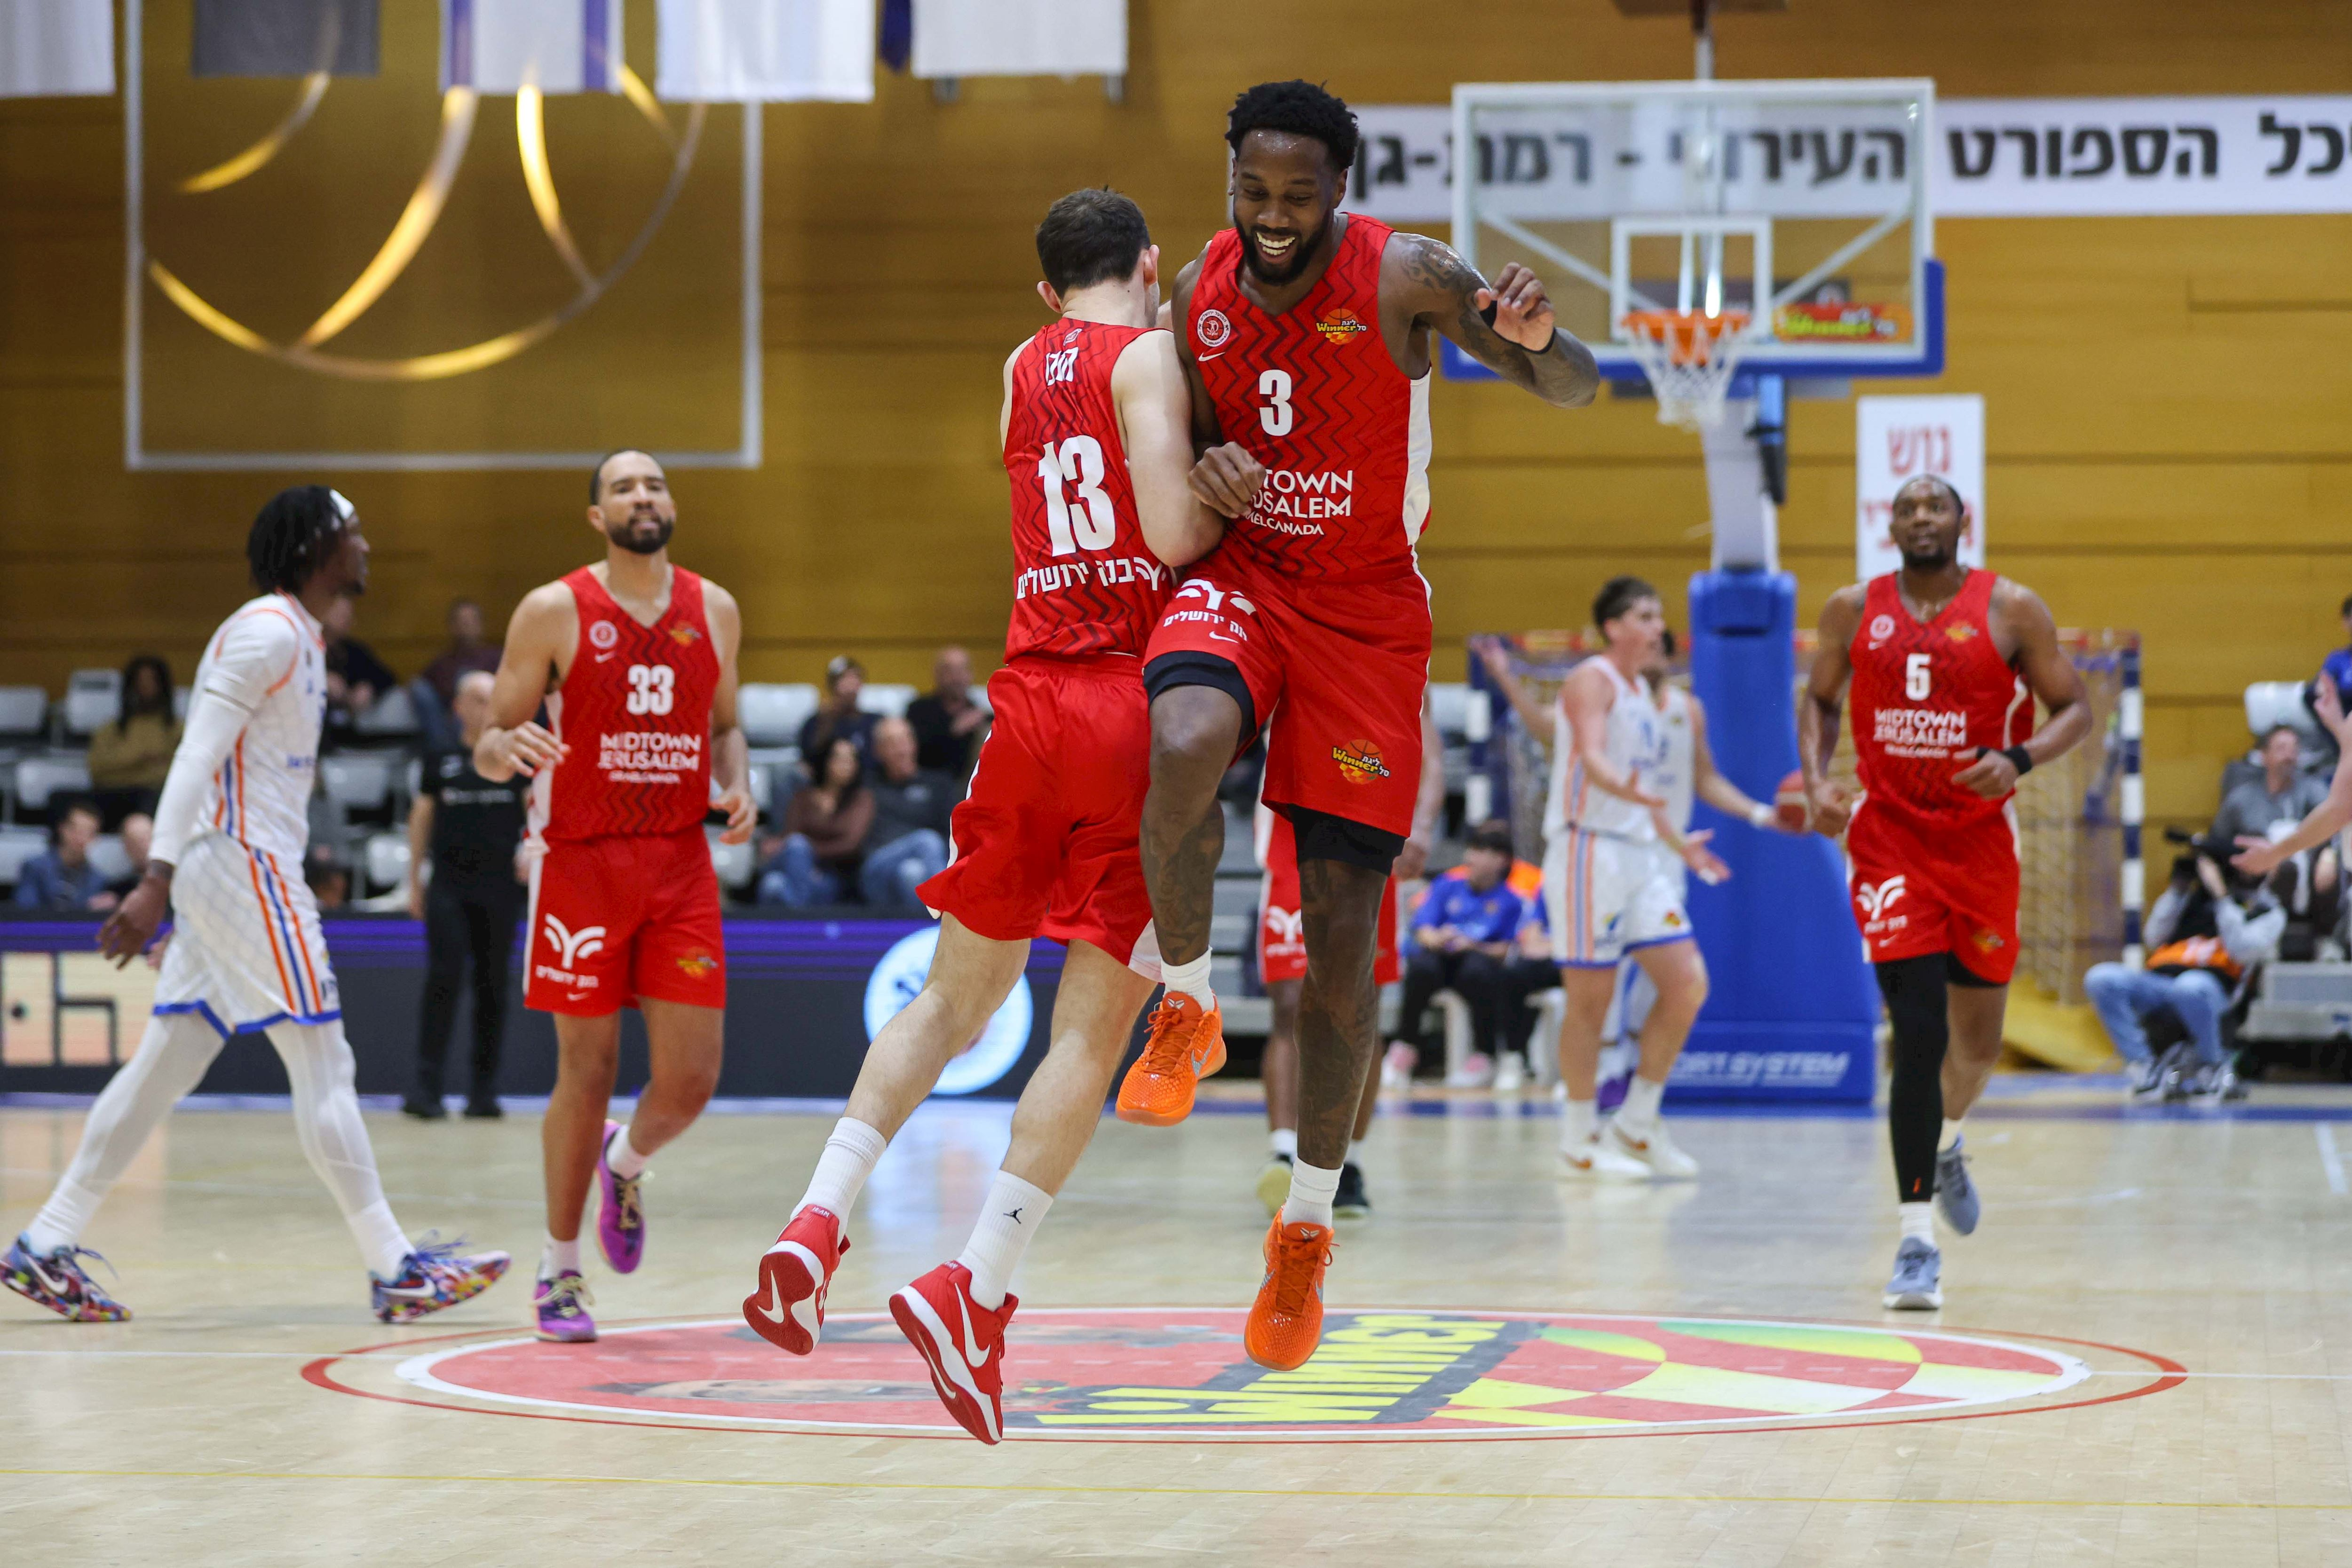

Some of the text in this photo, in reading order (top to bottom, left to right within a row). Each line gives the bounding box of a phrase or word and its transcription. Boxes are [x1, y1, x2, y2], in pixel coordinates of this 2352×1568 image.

[1669, 127, 1906, 187] העירוי
[1947, 126, 2218, 179] הספורט
[2259, 112, 2352, 176] כל
[1259, 369, 1292, 436] 3
[1038, 435, 1117, 557] 13
[1251, 490, 1351, 518] USALEM
[1263, 469, 1353, 494] TOWN
[1016, 562, 1090, 600] ירושלים
[1163, 610, 1225, 627] ירושלים
[627, 664, 674, 716] 33
[1905, 653, 1931, 701] 5
[600, 731, 702, 752] MIDTOWN
[1874, 707, 1967, 729] MIDTOWN
